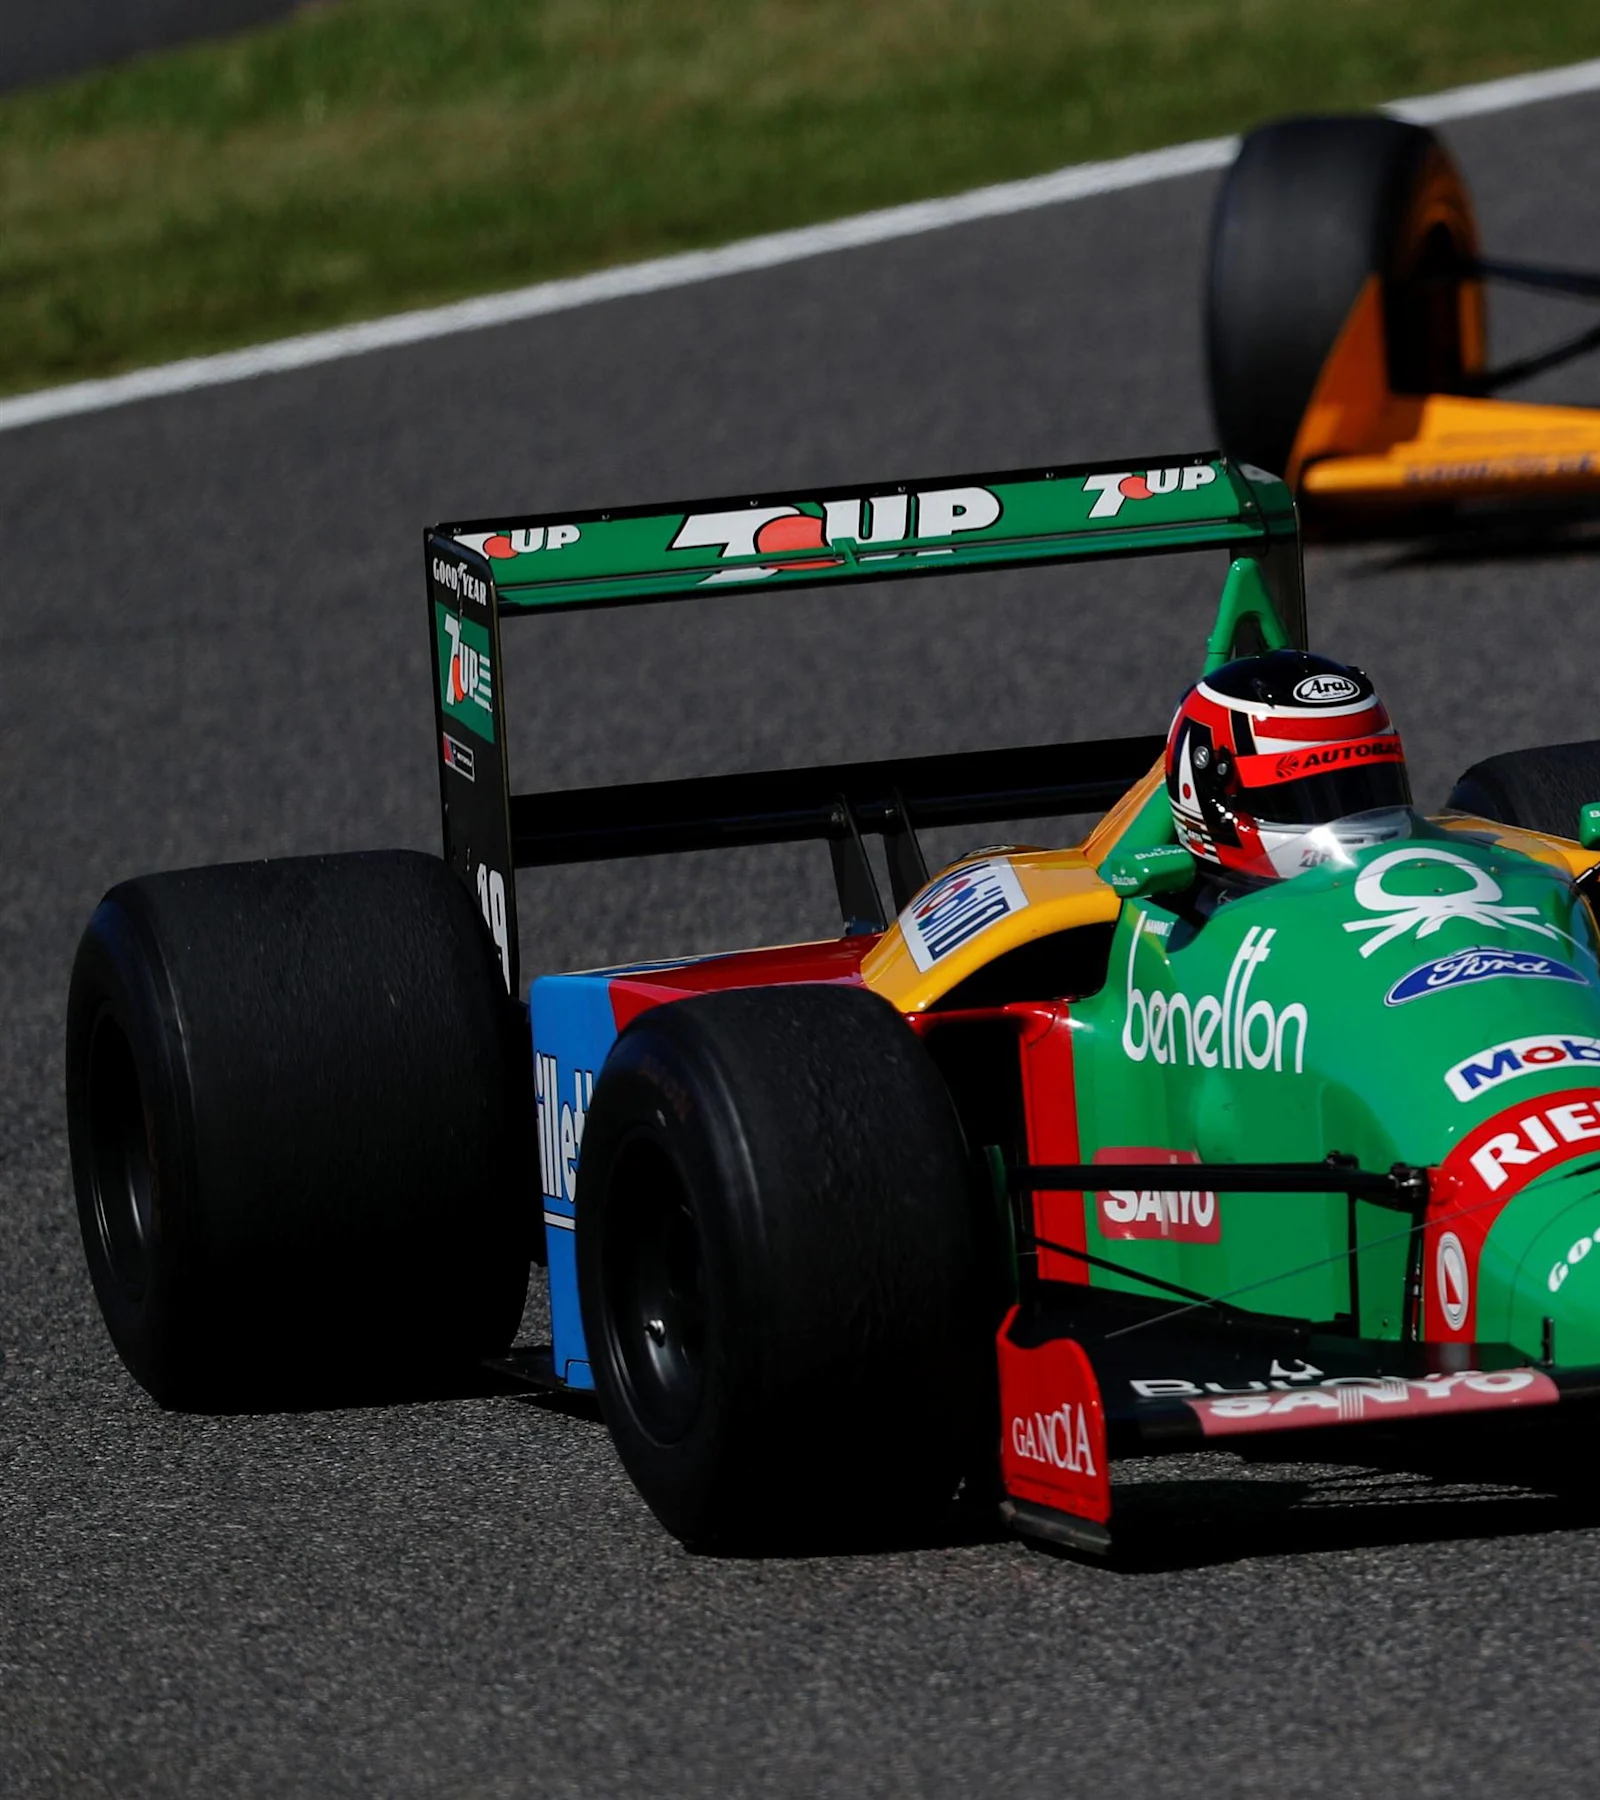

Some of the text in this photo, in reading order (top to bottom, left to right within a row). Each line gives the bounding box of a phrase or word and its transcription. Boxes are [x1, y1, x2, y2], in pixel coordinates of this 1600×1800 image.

[1083, 466, 1217, 518] 7UP
[671, 486, 1001, 585] 7UP
[432, 557, 487, 607] GOODYEAR
[444, 612, 480, 706] 7UP
[1302, 679, 1352, 699] Arai
[1134, 847, 1188, 863] BULOVA
[1122, 910, 1308, 1074] benetton
[1432, 950, 1551, 988] Ford
[1208, 1370, 1535, 1420] SANYO
[1010, 1402, 1098, 1478] GANCIA
